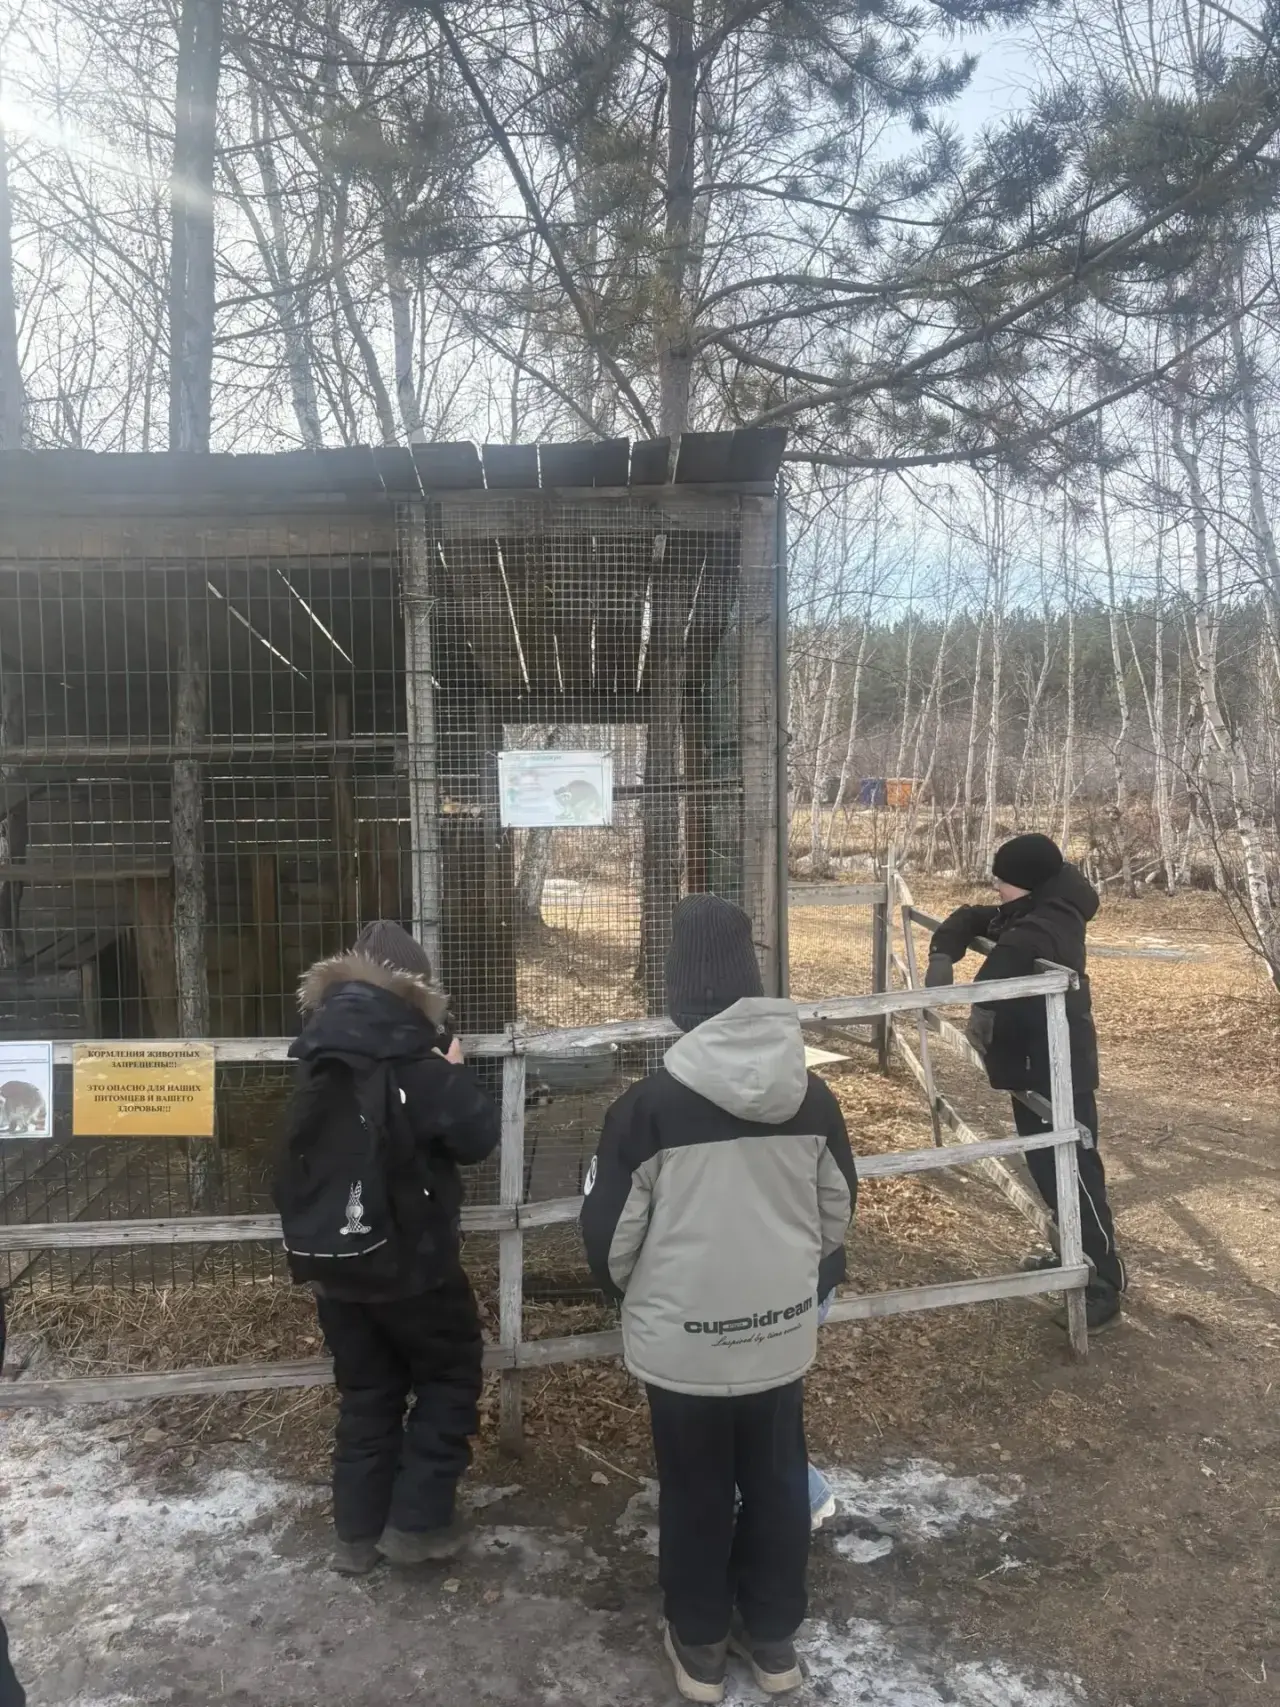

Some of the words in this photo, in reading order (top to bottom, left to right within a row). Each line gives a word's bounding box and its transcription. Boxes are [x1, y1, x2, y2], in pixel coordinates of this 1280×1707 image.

[87, 1050, 145, 1058] КОРМЛЕНИЯ
[146, 1050, 200, 1058] ЖИВОТНЫХ
[111, 1061, 177, 1069] ЗАПРЕЩЕНЫ!!!
[87, 1084, 105, 1092] ЭТО
[106, 1084, 145, 1092] ОПАСНО
[146, 1084, 166, 1092] ДЛЯ
[167, 1084, 201, 1092] НАШИХ
[94, 1095, 146, 1103] ПИТОМЦЕВ
[118, 1105, 171, 1113] ЗДОРОВЬЯ!!!
[683, 1296, 813, 1335] cupidream
